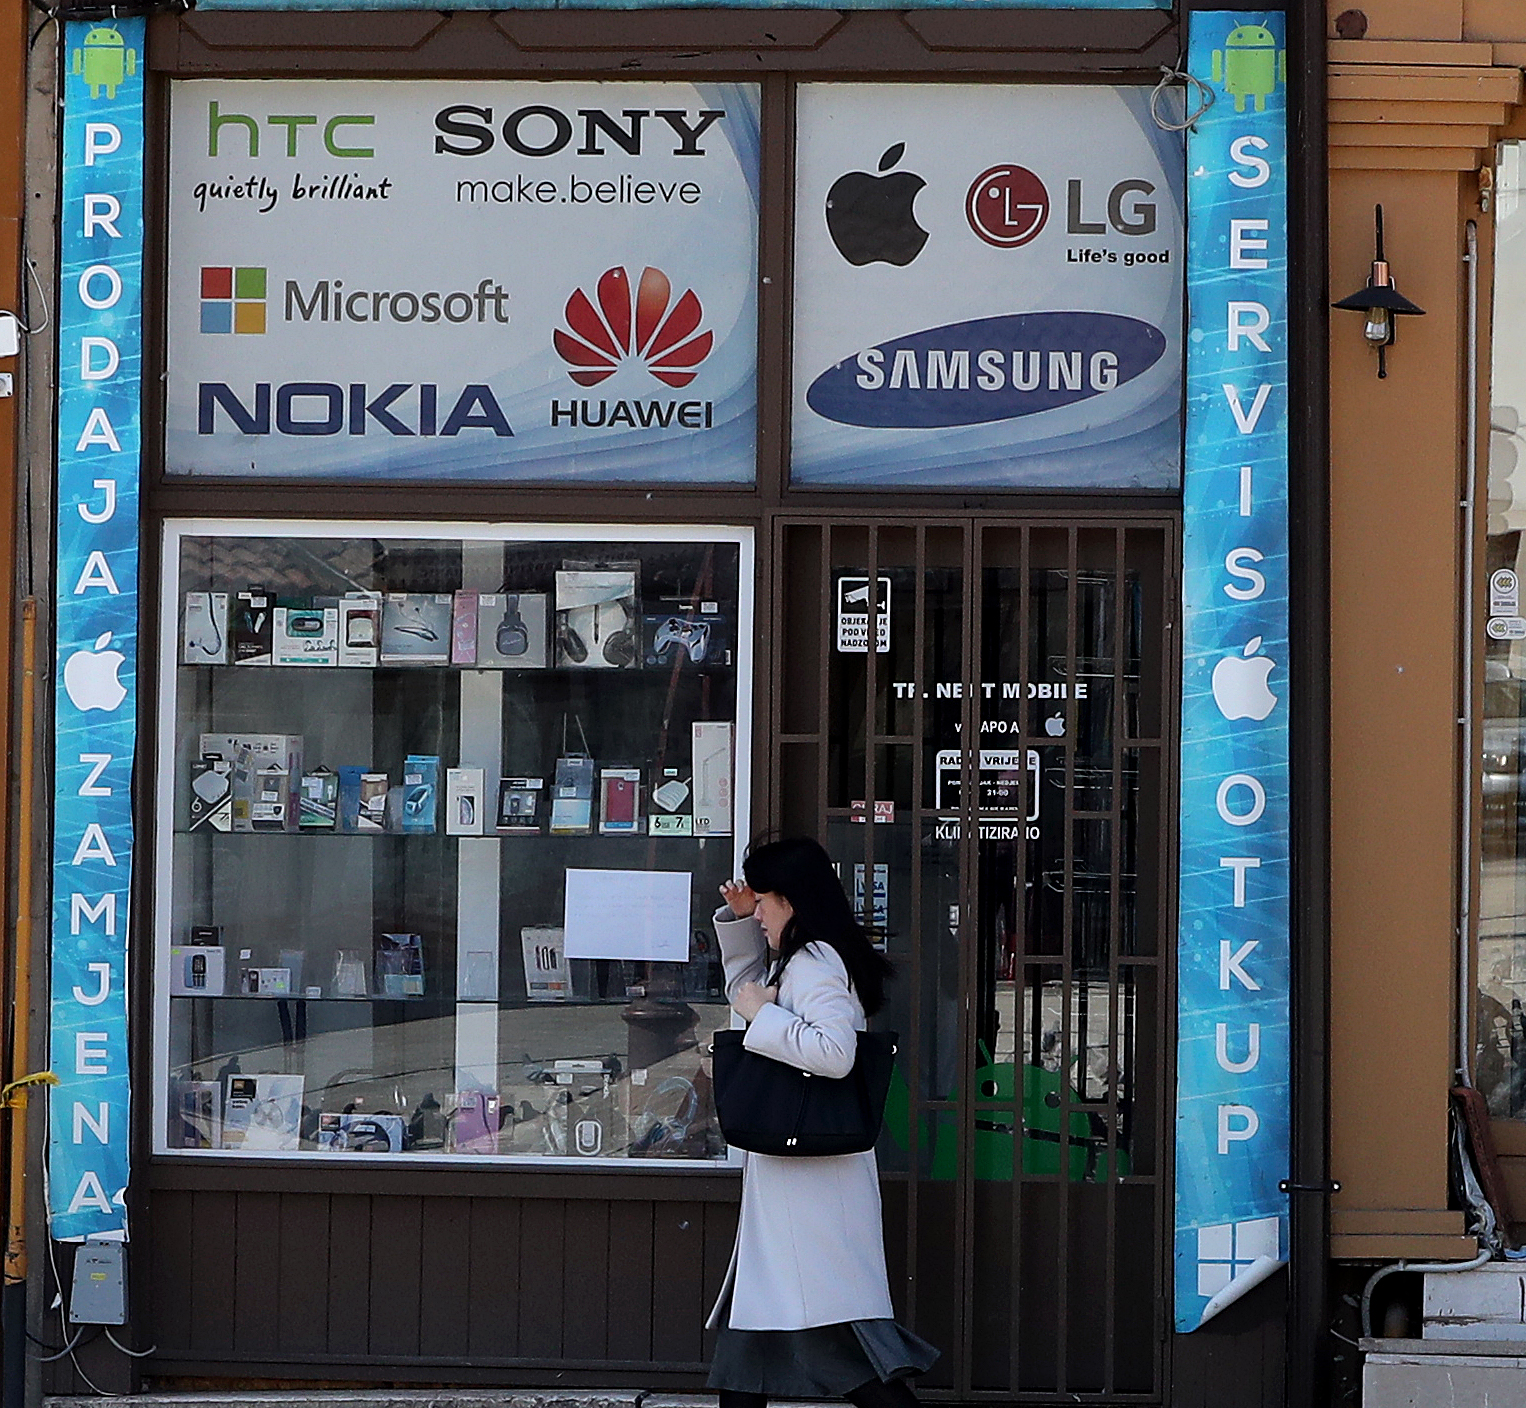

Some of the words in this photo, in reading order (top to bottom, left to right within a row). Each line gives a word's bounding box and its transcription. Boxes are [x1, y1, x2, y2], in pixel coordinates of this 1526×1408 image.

[433, 104, 727, 157] SONY
[193, 174, 279, 213] quietly
[291, 173, 394, 202] brilliant
[455, 173, 702, 205] make.believe
[1066, 177, 1157, 238] LG
[1067, 247, 1119, 264] Life's
[1123, 248, 1171, 268] good
[283, 279, 510, 326] Microsoft
[74, 122, 125, 598] PRODAJA
[856, 347, 1119, 392] SAMSUNG
[1223, 135, 1272, 601] SERVIS
[198, 383, 515, 437] NOKIA
[550, 399, 714, 429] HUAWEI
[936, 682, 995, 699] NET
[984, 757, 1036, 765] VRIJEE
[67, 752, 116, 1215] ZAMJENA
[1213, 772, 1266, 1155] OTKUP
